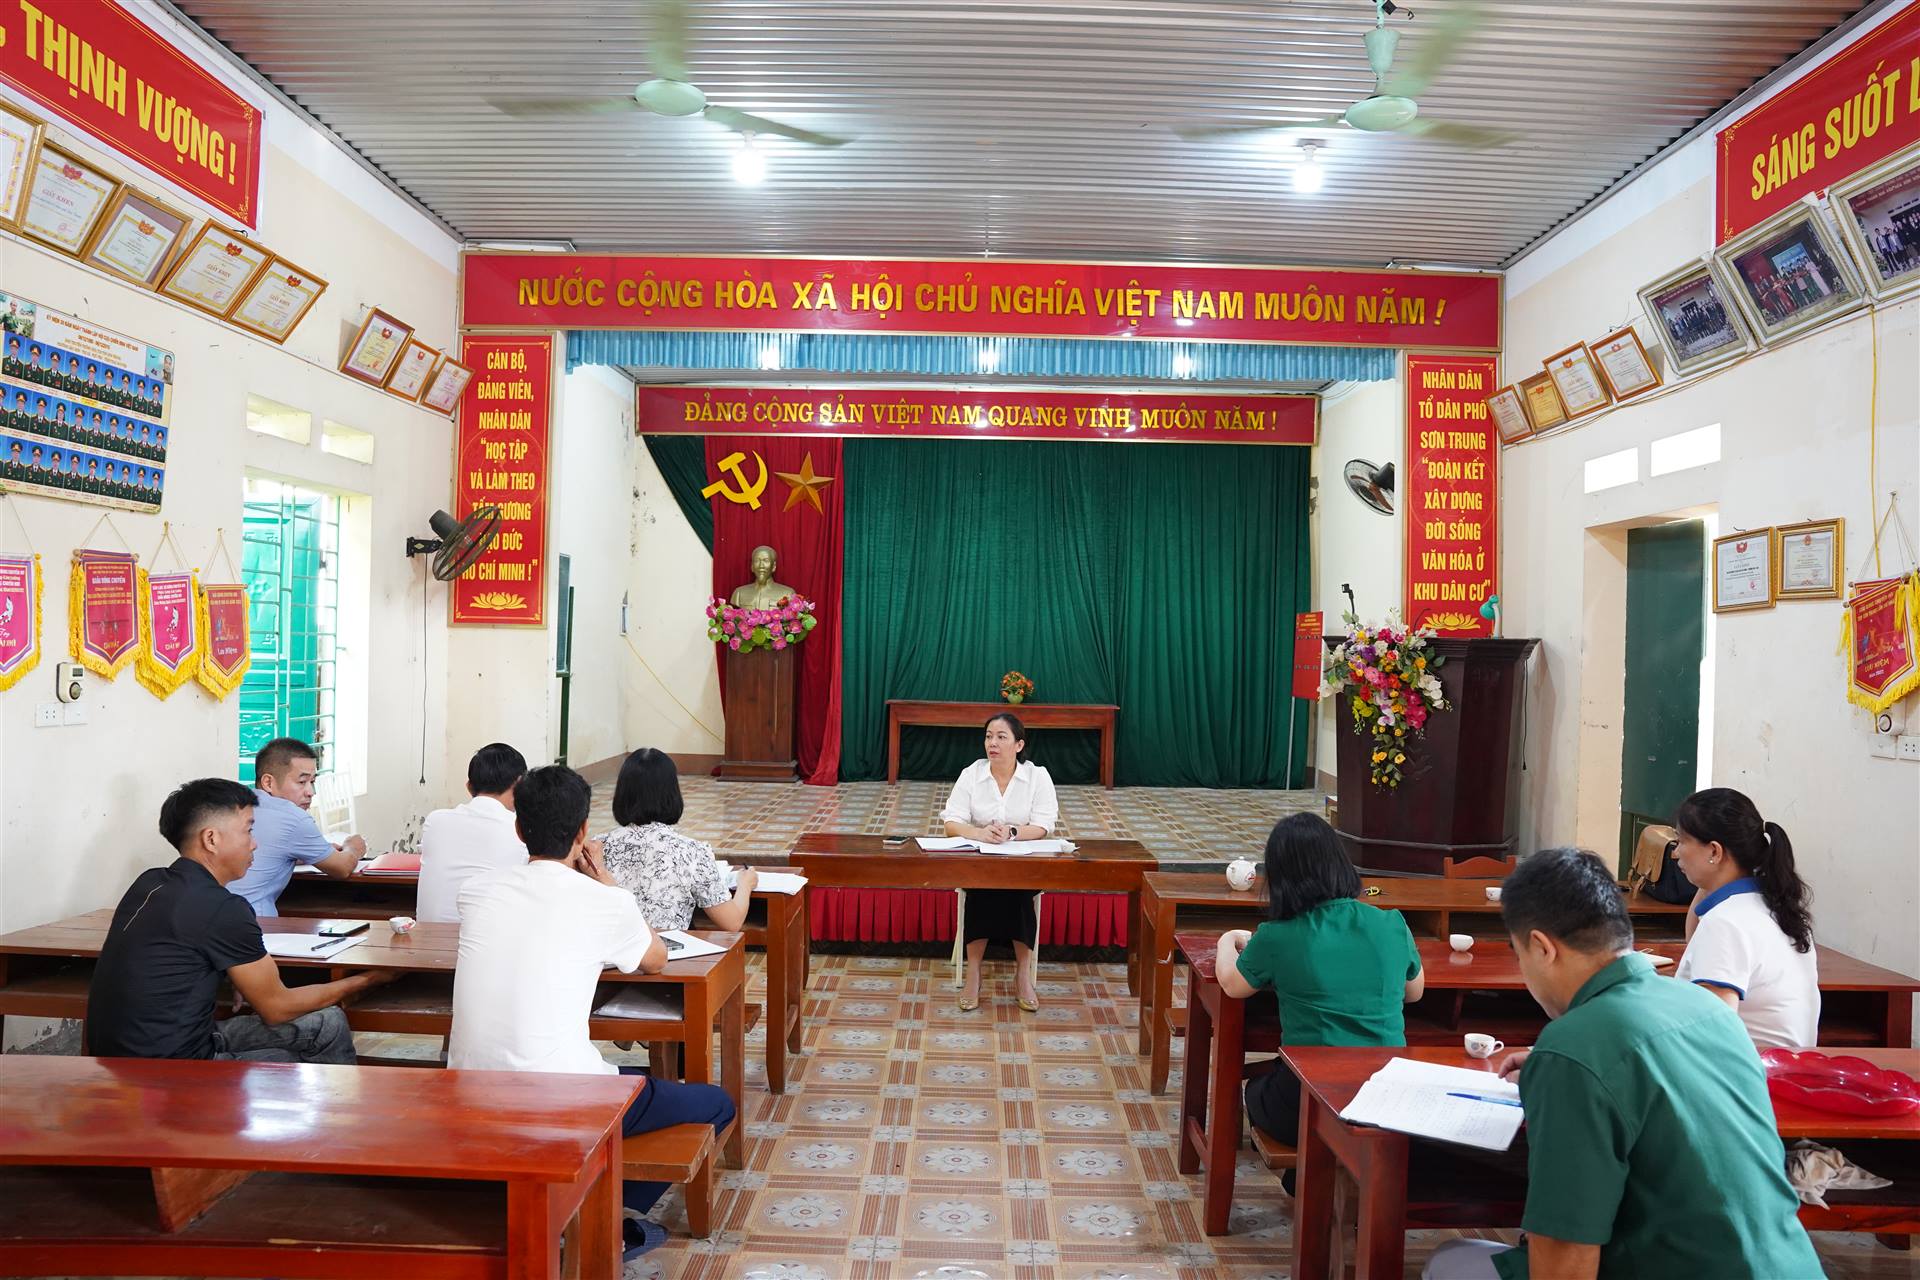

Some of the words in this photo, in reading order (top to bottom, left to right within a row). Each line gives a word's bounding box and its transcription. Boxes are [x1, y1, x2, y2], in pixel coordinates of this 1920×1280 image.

[20, 0, 127, 116] THỊNH
[1752, 122, 1815, 201] SÁNG
[1824, 59, 1901, 160] SUỐT
[518, 267, 604, 306] NƯỚC
[618, 272, 702, 314] CỘNG
[716, 271, 777, 308] HÒA
[791, 271, 838, 311] XÃ
[851, 273, 903, 319] HỘI
[916, 273, 977, 311] CHỦ
[991, 280, 1085, 314] NGHĨA
[1095, 280, 1158, 325] VIỆT
[1171, 289, 1244, 320] NAM
[1255, 286, 1344, 321] MUÔN
[1358, 289, 1424, 324] NĂM
[487, 349, 508, 369] CÁN
[511, 349, 527, 373] BỘ,
[478, 375, 505, 399] ĐẢNG
[509, 378, 535, 402] VIÊN,
[1423, 369, 1455, 389] NHÂN
[1459, 370, 1482, 389] DÂN
[685, 393, 747, 422] ĐẢNG
[754, 396, 816, 427] CỘNG
[818, 394, 865, 426] SẢN
[871, 399, 923, 429] VIỆT
[931, 405, 983, 429] NAM
[986, 406, 1067, 429] QUANG
[1074, 406, 1133, 428] VINH
[1140, 403, 1206, 429] MUÔN
[1215, 408, 1264, 430] NĂM
[1419, 395, 1433, 418] TỔ
[1437, 399, 1460, 419] DÂN
[479, 409, 507, 429] NHÂN
[510, 409, 531, 429] DÂN
[509, 439, 528, 463] TẬP
[1421, 430, 1445, 448] SƠN
[1448, 432, 1485, 449] TRUNG
[471, 469, 483, 489] VÀ
[486, 469, 508, 489] LÀM
[511, 473, 535, 490] THEO
[1464, 457, 1485, 479] KẾT
[1424, 489, 1447, 509] XÂY
[1451, 491, 1482, 513] DỰNG
[503, 528, 522, 550] ĐỨC
[1425, 518, 1445, 539] ĐỜI
[1449, 517, 1481, 540] SỐNG
[479, 560, 495, 580] CHÍ
[499, 563, 525, 580] MINH
[1422, 549, 1446, 570] VĂN
[1450, 550, 1472, 570] HÓA
[1414, 583, 1437, 600] KHU
[1442, 580, 1465, 600] DÂN
